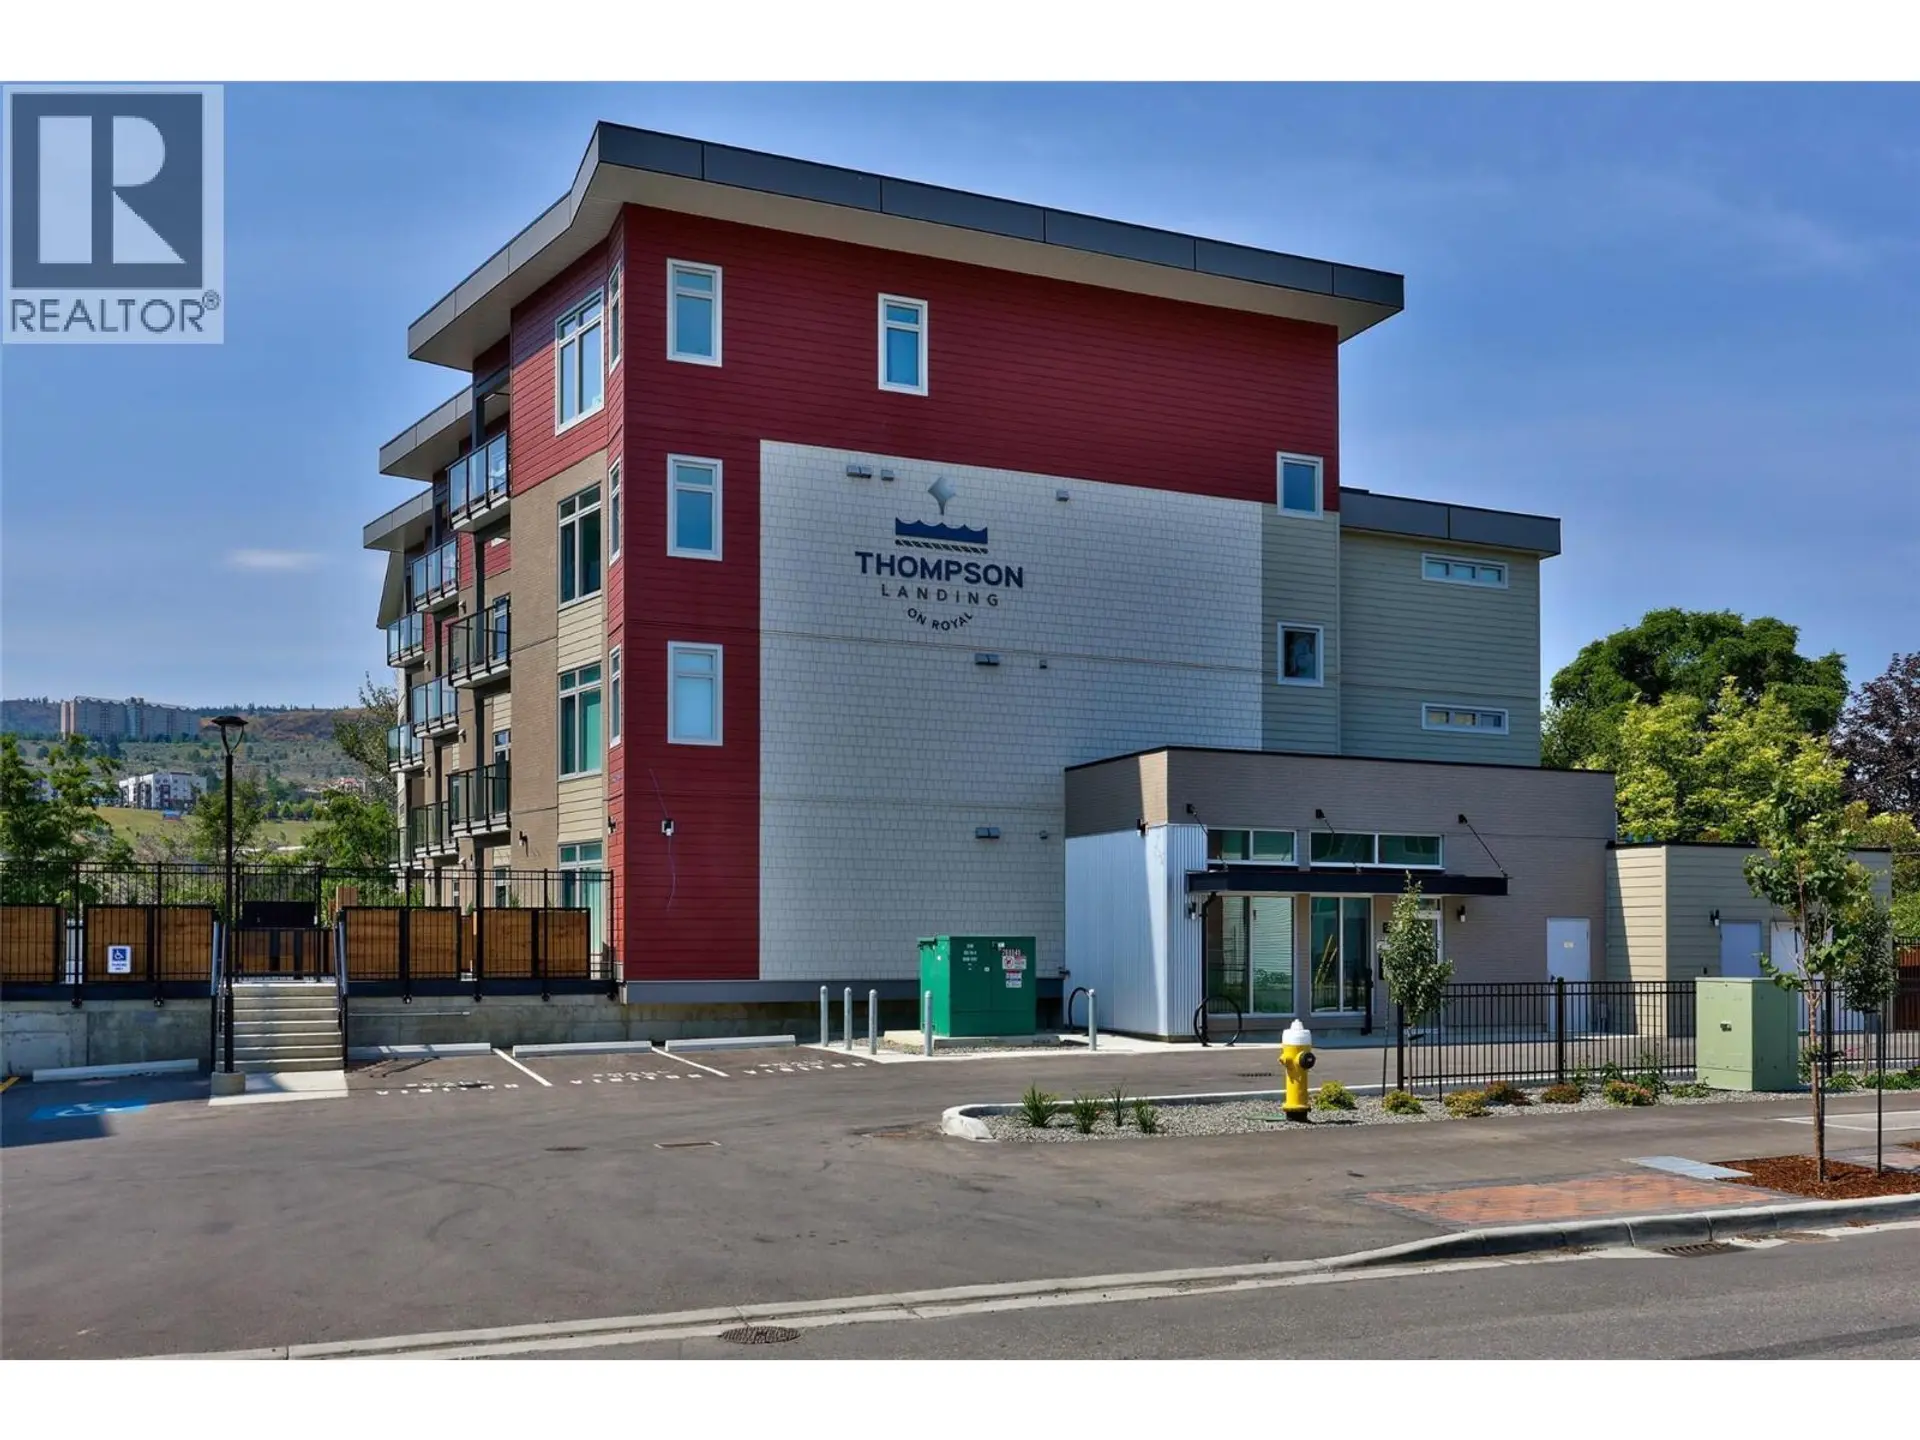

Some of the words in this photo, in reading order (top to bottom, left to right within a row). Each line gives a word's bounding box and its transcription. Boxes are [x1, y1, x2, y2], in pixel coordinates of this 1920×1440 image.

[855, 551, 1024, 588] THOMPSON
[881, 584, 999, 607] LANDING
[907, 608, 927, 625] ON
[931, 612, 974, 631] ROYAL
